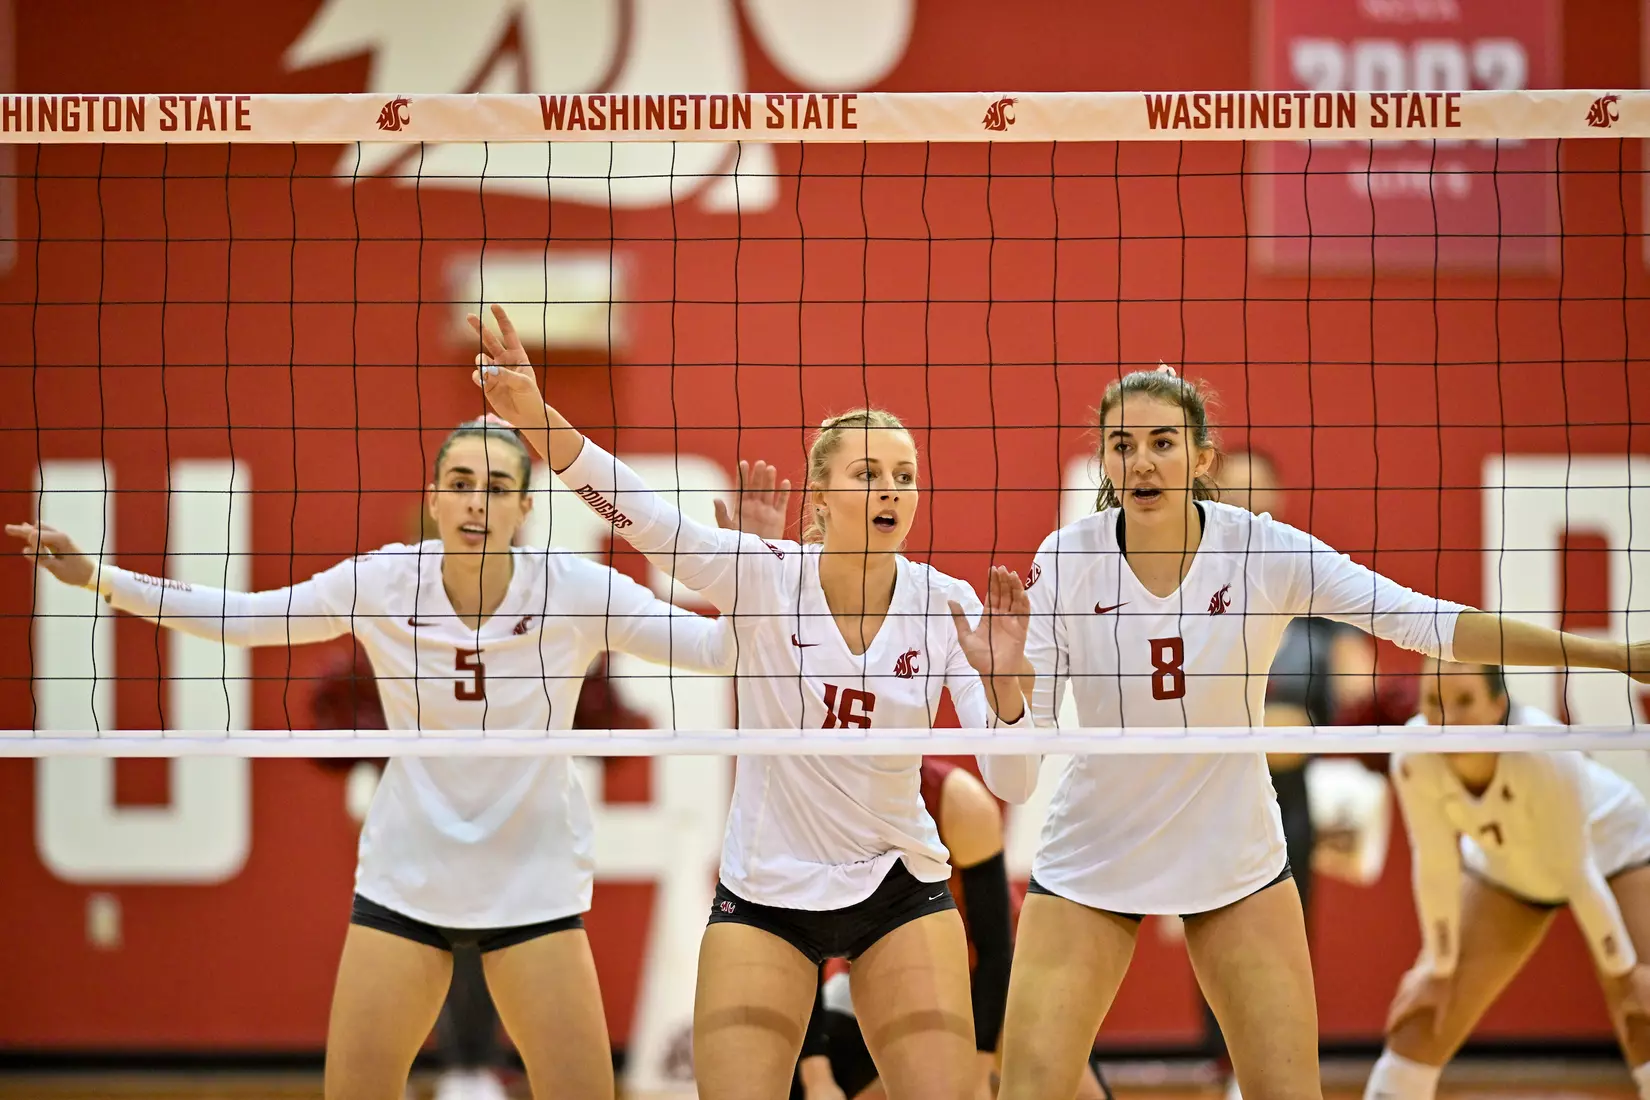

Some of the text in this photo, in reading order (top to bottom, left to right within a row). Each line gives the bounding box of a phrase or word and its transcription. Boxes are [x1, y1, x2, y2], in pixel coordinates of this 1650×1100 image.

[158, 96, 252, 132] STATE
[539, 93, 858, 131] WASHINGTON STATE
[1144, 92, 1462, 130] WASHINGTON STATE
[575, 483, 634, 529] COUGARS
[454, 646, 486, 701] 5
[1147, 636, 1186, 700] 8
[821, 682, 876, 729] 16
